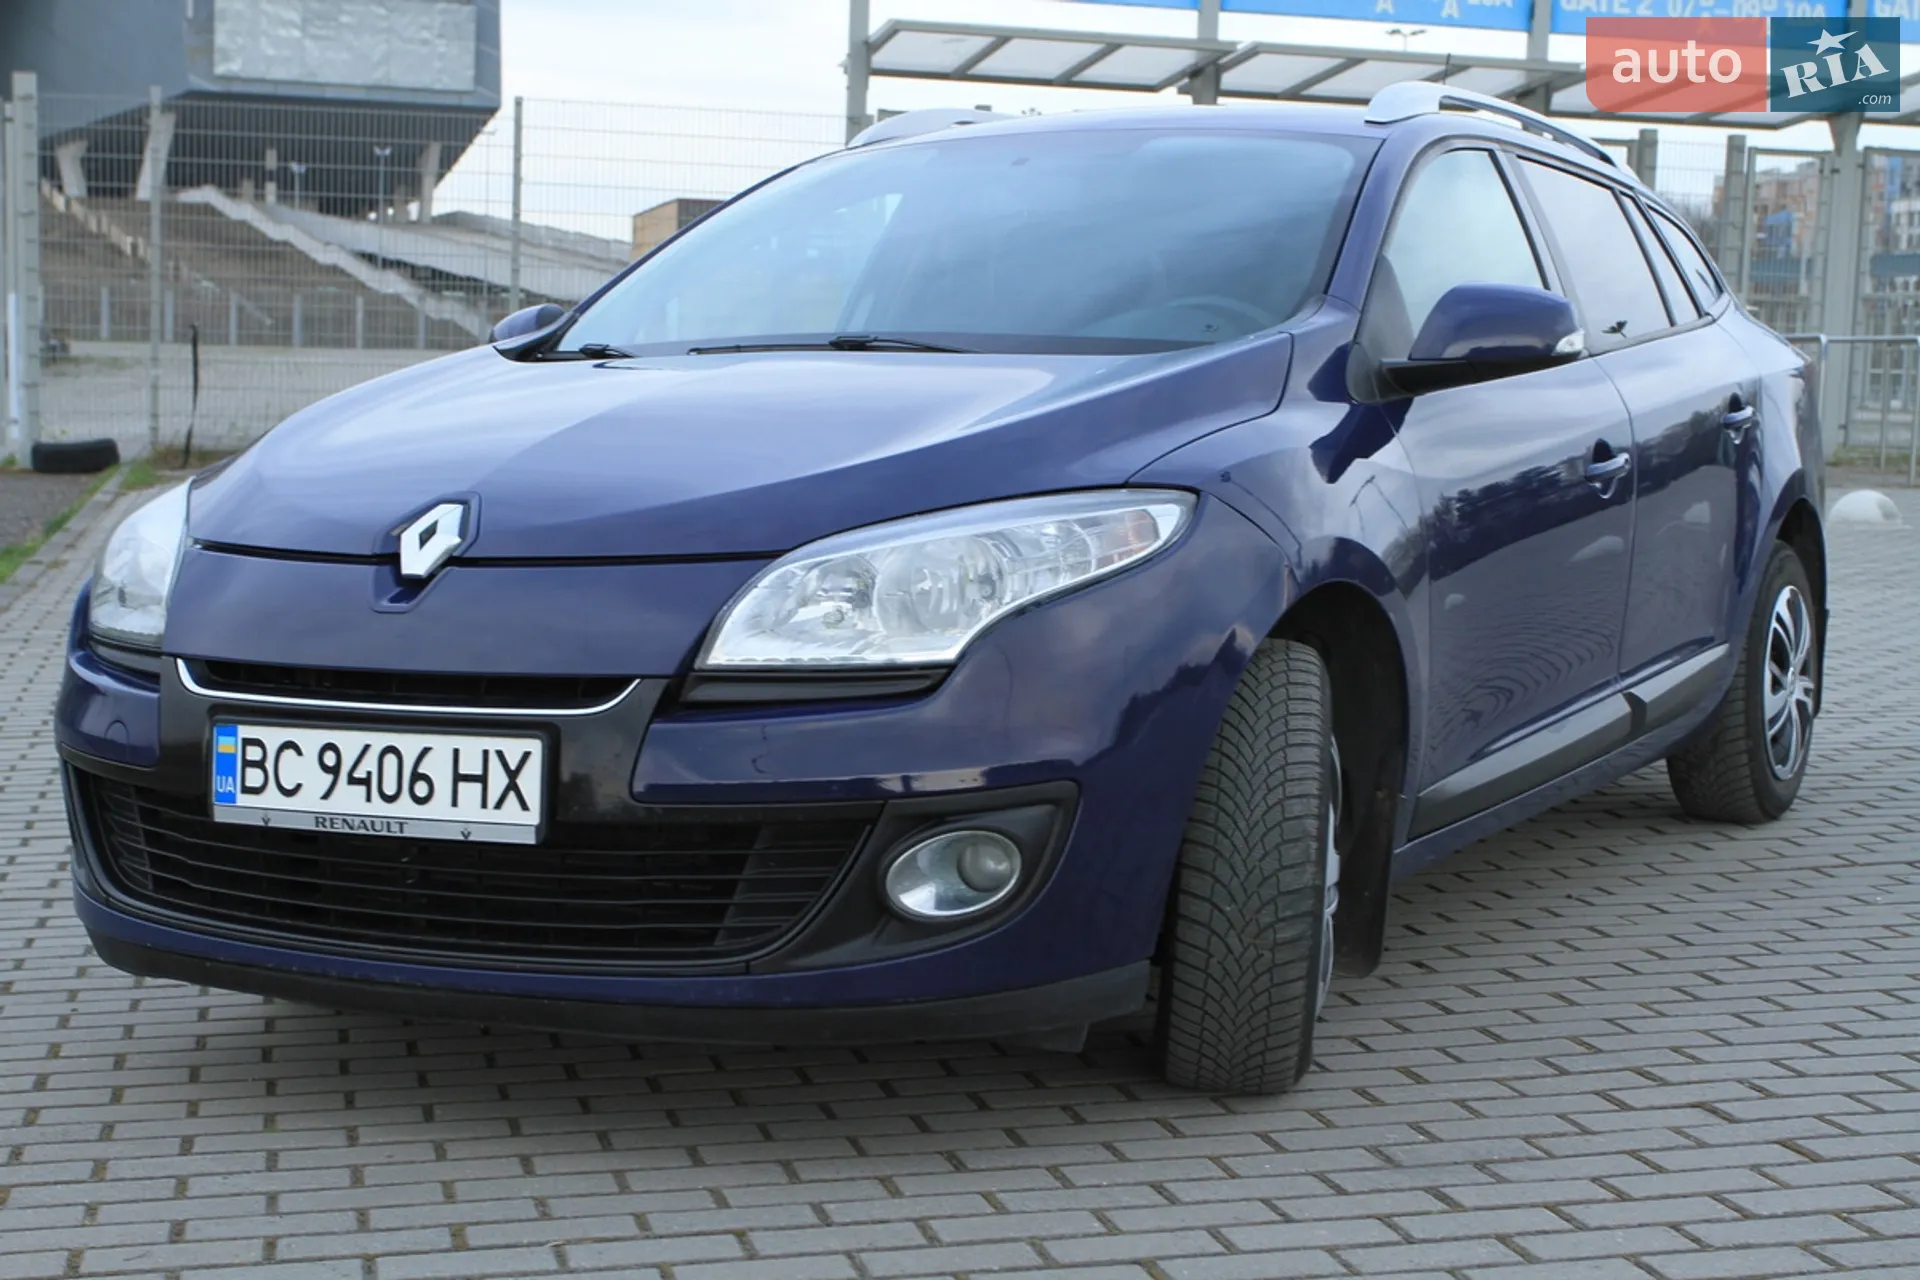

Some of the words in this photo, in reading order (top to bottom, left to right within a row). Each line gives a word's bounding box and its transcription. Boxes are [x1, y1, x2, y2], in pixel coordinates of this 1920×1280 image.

[216, 775, 235, 794] UA
[240, 737, 304, 797] BC
[317, 742, 435, 806] 9406
[450, 748, 532, 812] HX
[314, 815, 408, 835] RENAULT
